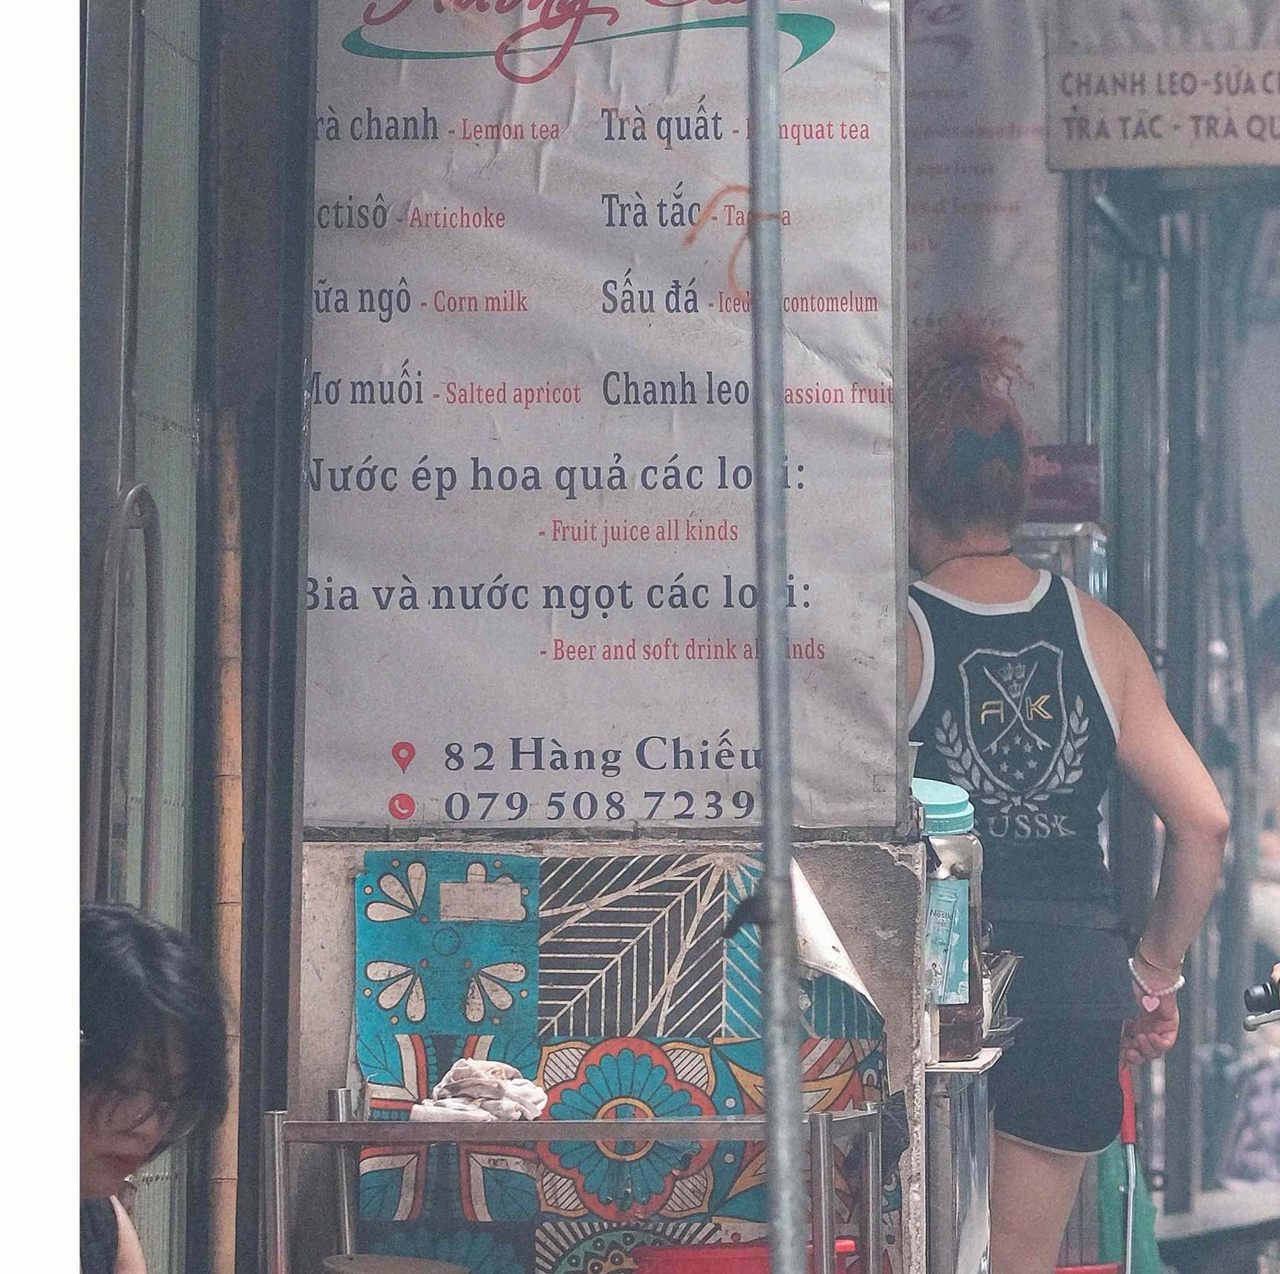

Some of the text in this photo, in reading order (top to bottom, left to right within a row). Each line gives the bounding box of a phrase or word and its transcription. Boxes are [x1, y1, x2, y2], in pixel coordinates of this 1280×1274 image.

[1060, 70, 1147, 97] CHANH
[314, 105, 341, 141] rà
[350, 107, 439, 141] chanh
[461, 118, 525, 140] Lemon
[530, 120, 561, 140] tea
[601, 105, 647, 141] Trà
[656, 94, 723, 150] quất
[840, 120, 870, 140] tea
[317, 192, 388, 229] ctisô
[409, 206, 506, 229] Artichoke
[601, 191, 648, 227] Trà
[656, 180, 701, 227] tắc
[314, 278, 349, 313] ữa
[358, 276, 411, 323] ngô
[434, 290, 478, 313] Corn
[484, 289, 528, 312] milk
[602, 268, 655, 314] Sấu
[665, 277, 700, 313] đá
[783, 290, 878, 313] contomelum
[350, 358, 423, 405] muối
[446, 381, 508, 404] Salted
[513, 381, 582, 410] apricot
[602, 371, 894, 405] Chanh leo assion fruit
[411, 454, 457, 501] ép
[470, 457, 542, 491] hoa
[555, 453, 627, 500] quả
[640, 453, 703, 490] các
[717, 456, 804, 490] loi:
[552, 519, 597, 542] Fruit
[602, 519, 650, 547] juice
[655, 519, 680, 541] all
[685, 519, 738, 541] kinds
[372, 573, 419, 611] và
[431, 573, 529, 610] nước
[543, 580, 633, 619] ngọt
[647, 572, 709, 609] các
[723, 573, 810, 609] loi:
[553, 638, 597, 661] Beer
[602, 638, 637, 660] and
[642, 637, 680, 660] soft
[685, 637, 737, 660] drink
[743, 638, 759, 659] al
[785, 637, 825, 660] inds
[444, 728, 763, 778] 82 Hàng Chiếu
[445, 790, 755, 821] 079 508 7239
